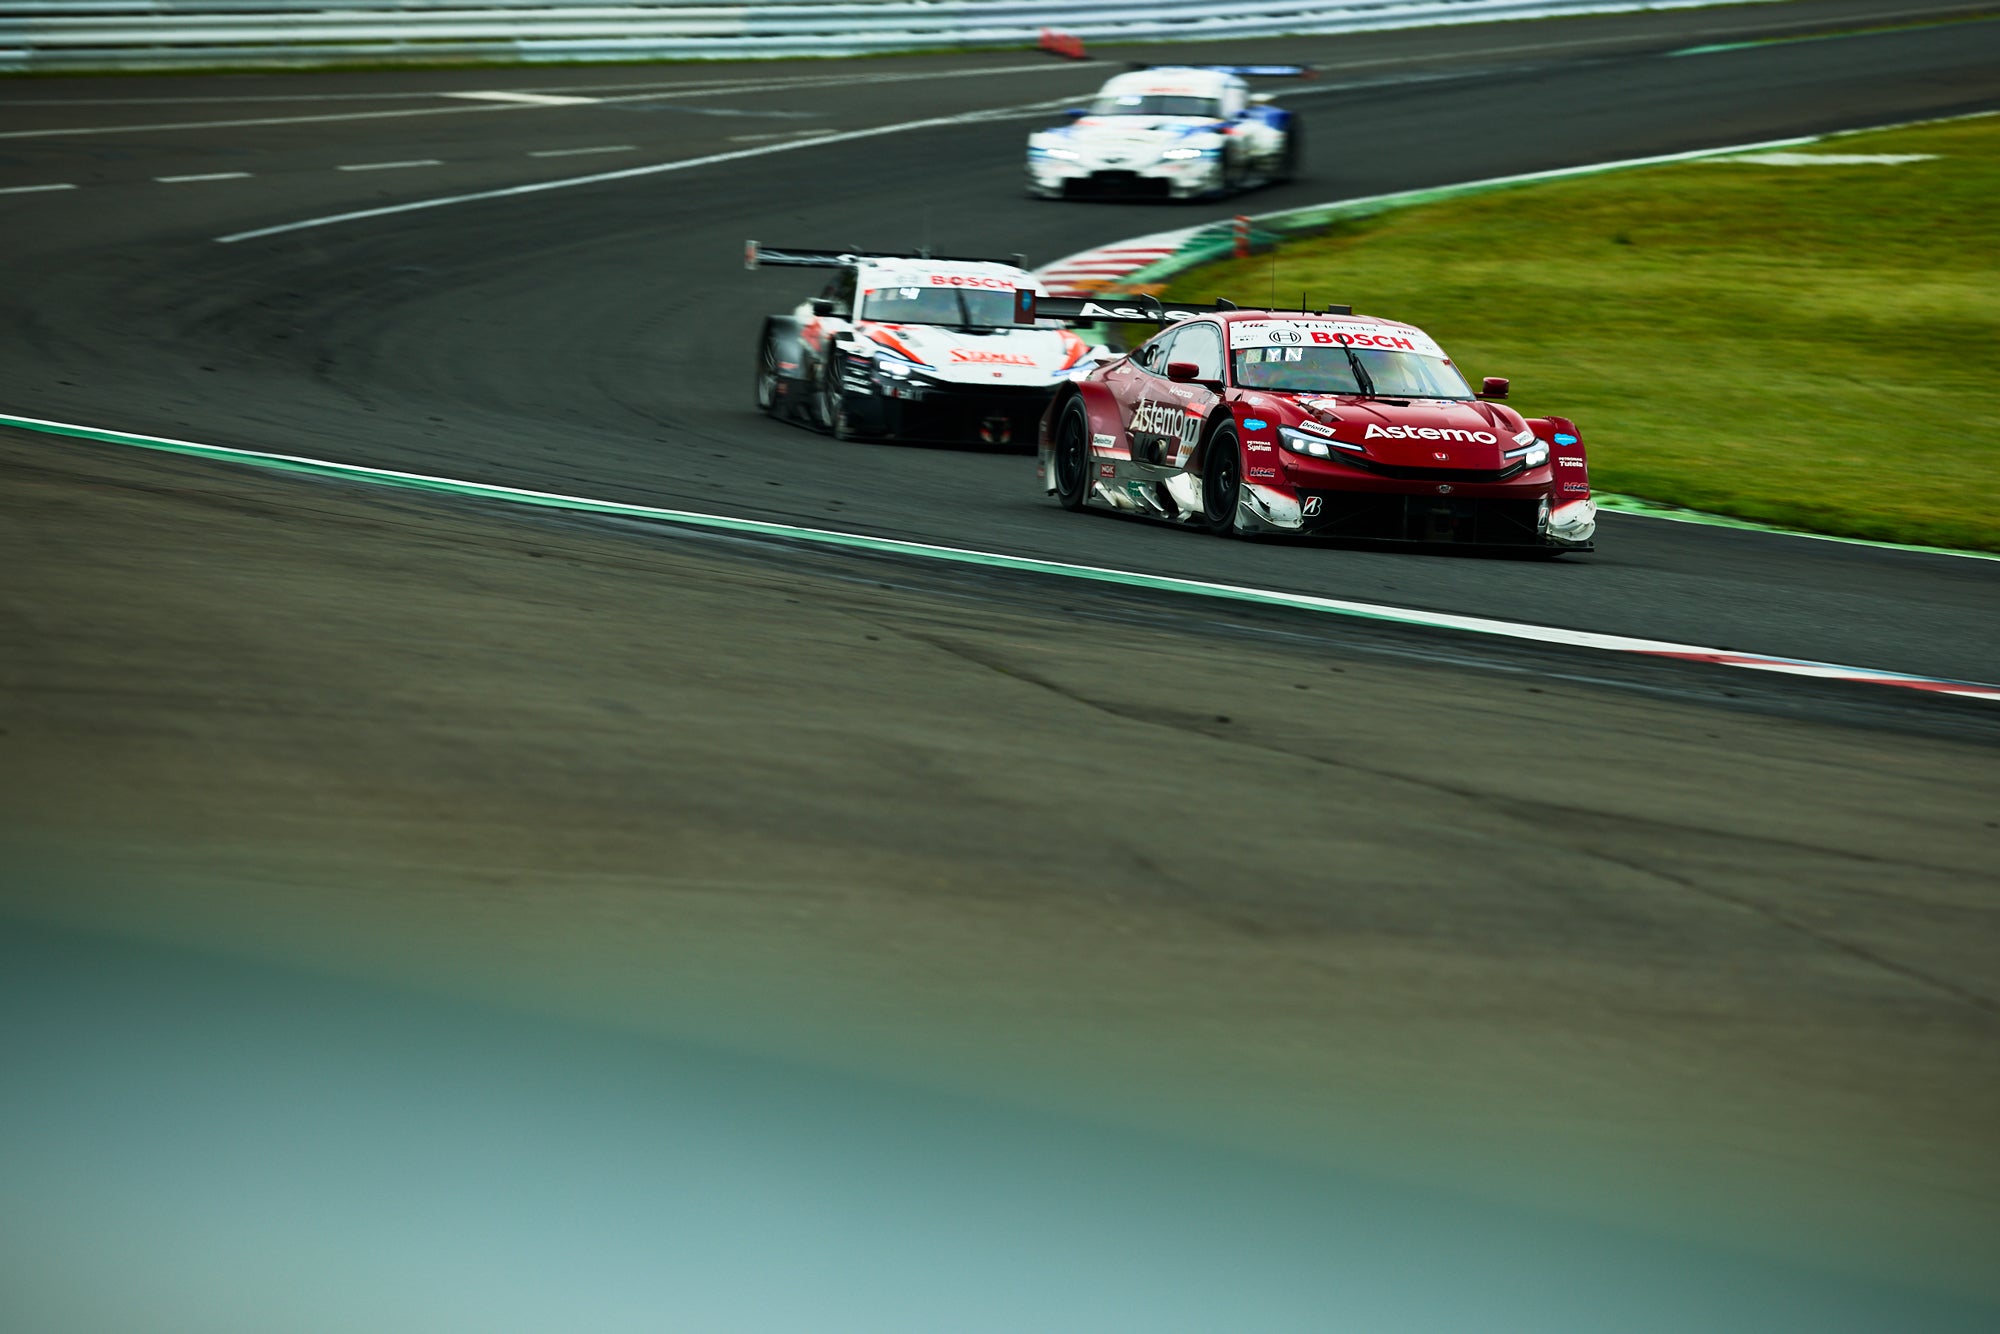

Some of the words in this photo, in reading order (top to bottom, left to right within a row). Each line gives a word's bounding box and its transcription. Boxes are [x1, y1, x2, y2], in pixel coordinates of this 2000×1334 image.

[931, 275, 1016, 290] BOSCH
[1314, 323, 1377, 332] Honda
[1310, 331, 1415, 351] BOSCH
[1129, 398, 1184, 438] Astemo
[1302, 421, 1330, 434] Deloitte
[1184, 418, 1198, 442] 17
[1364, 423, 1497, 445] Astemo
